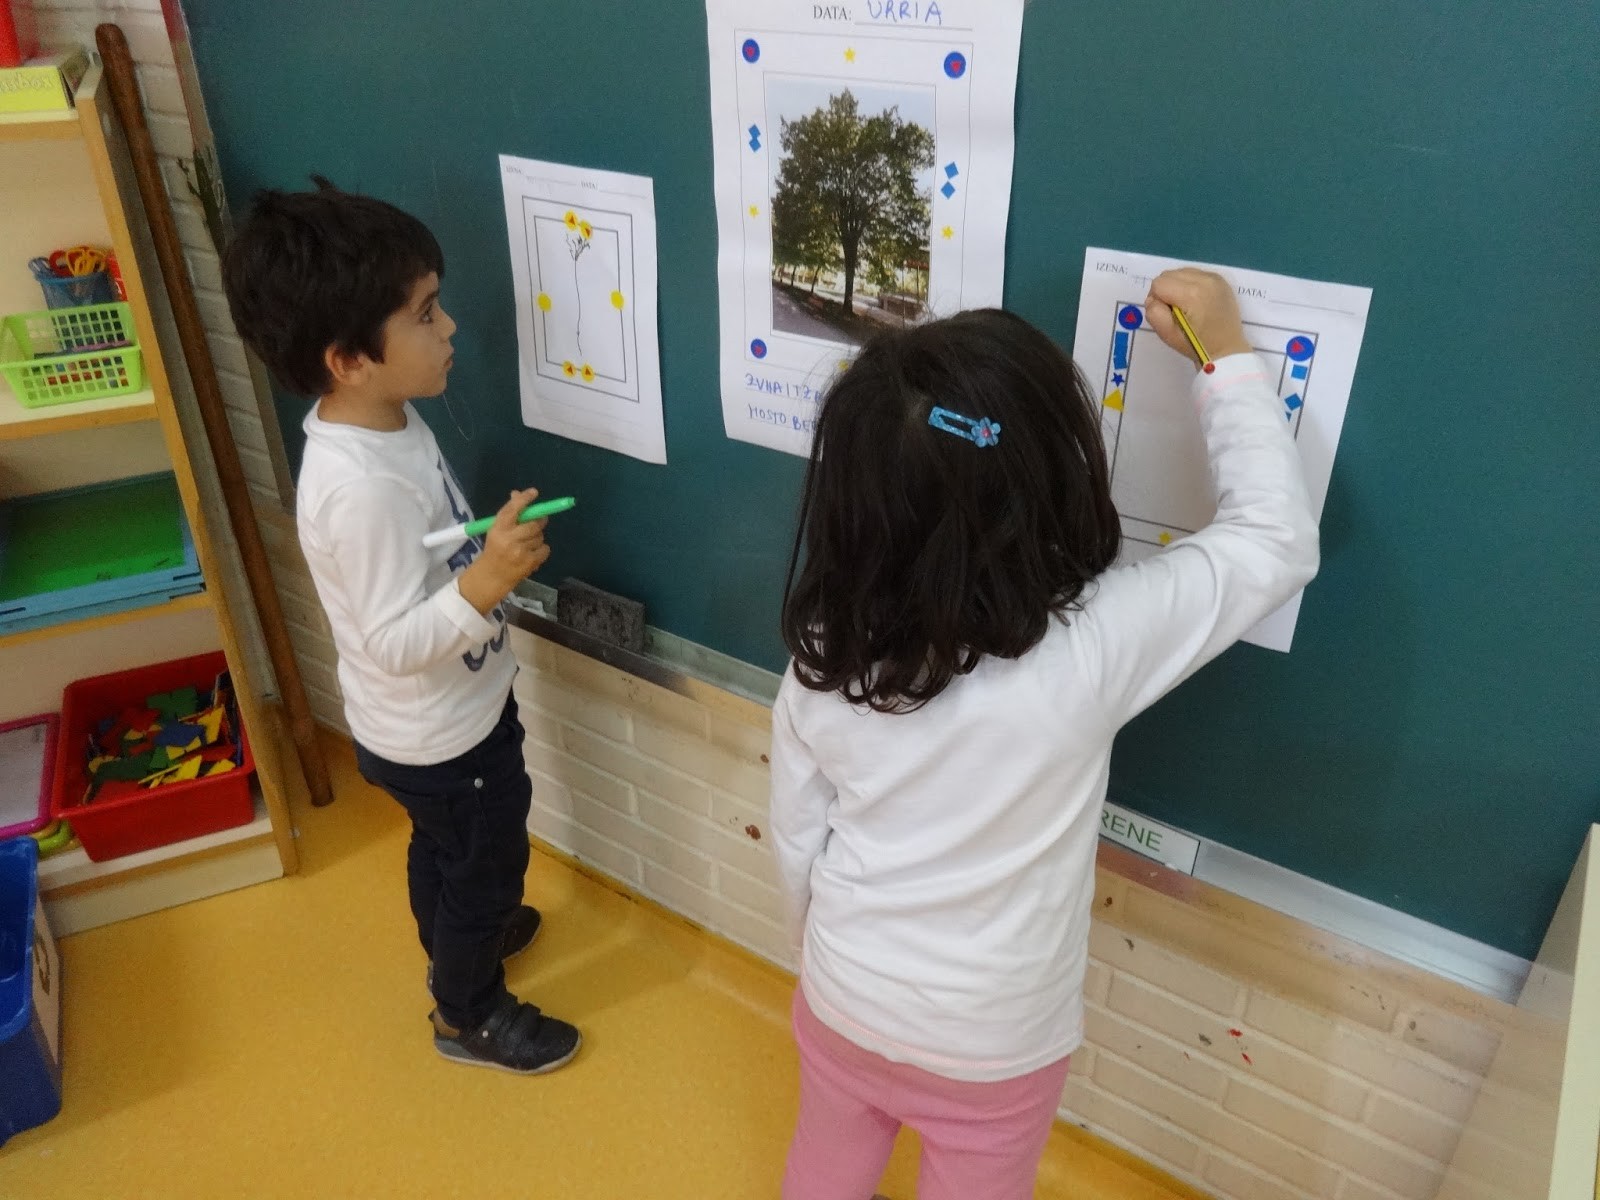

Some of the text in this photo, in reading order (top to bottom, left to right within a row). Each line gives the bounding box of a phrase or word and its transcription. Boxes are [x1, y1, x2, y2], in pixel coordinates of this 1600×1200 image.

[813, 0, 942, 26] DATA: URRIA
[1096, 262, 1267, 300] IZENA: DATA:
